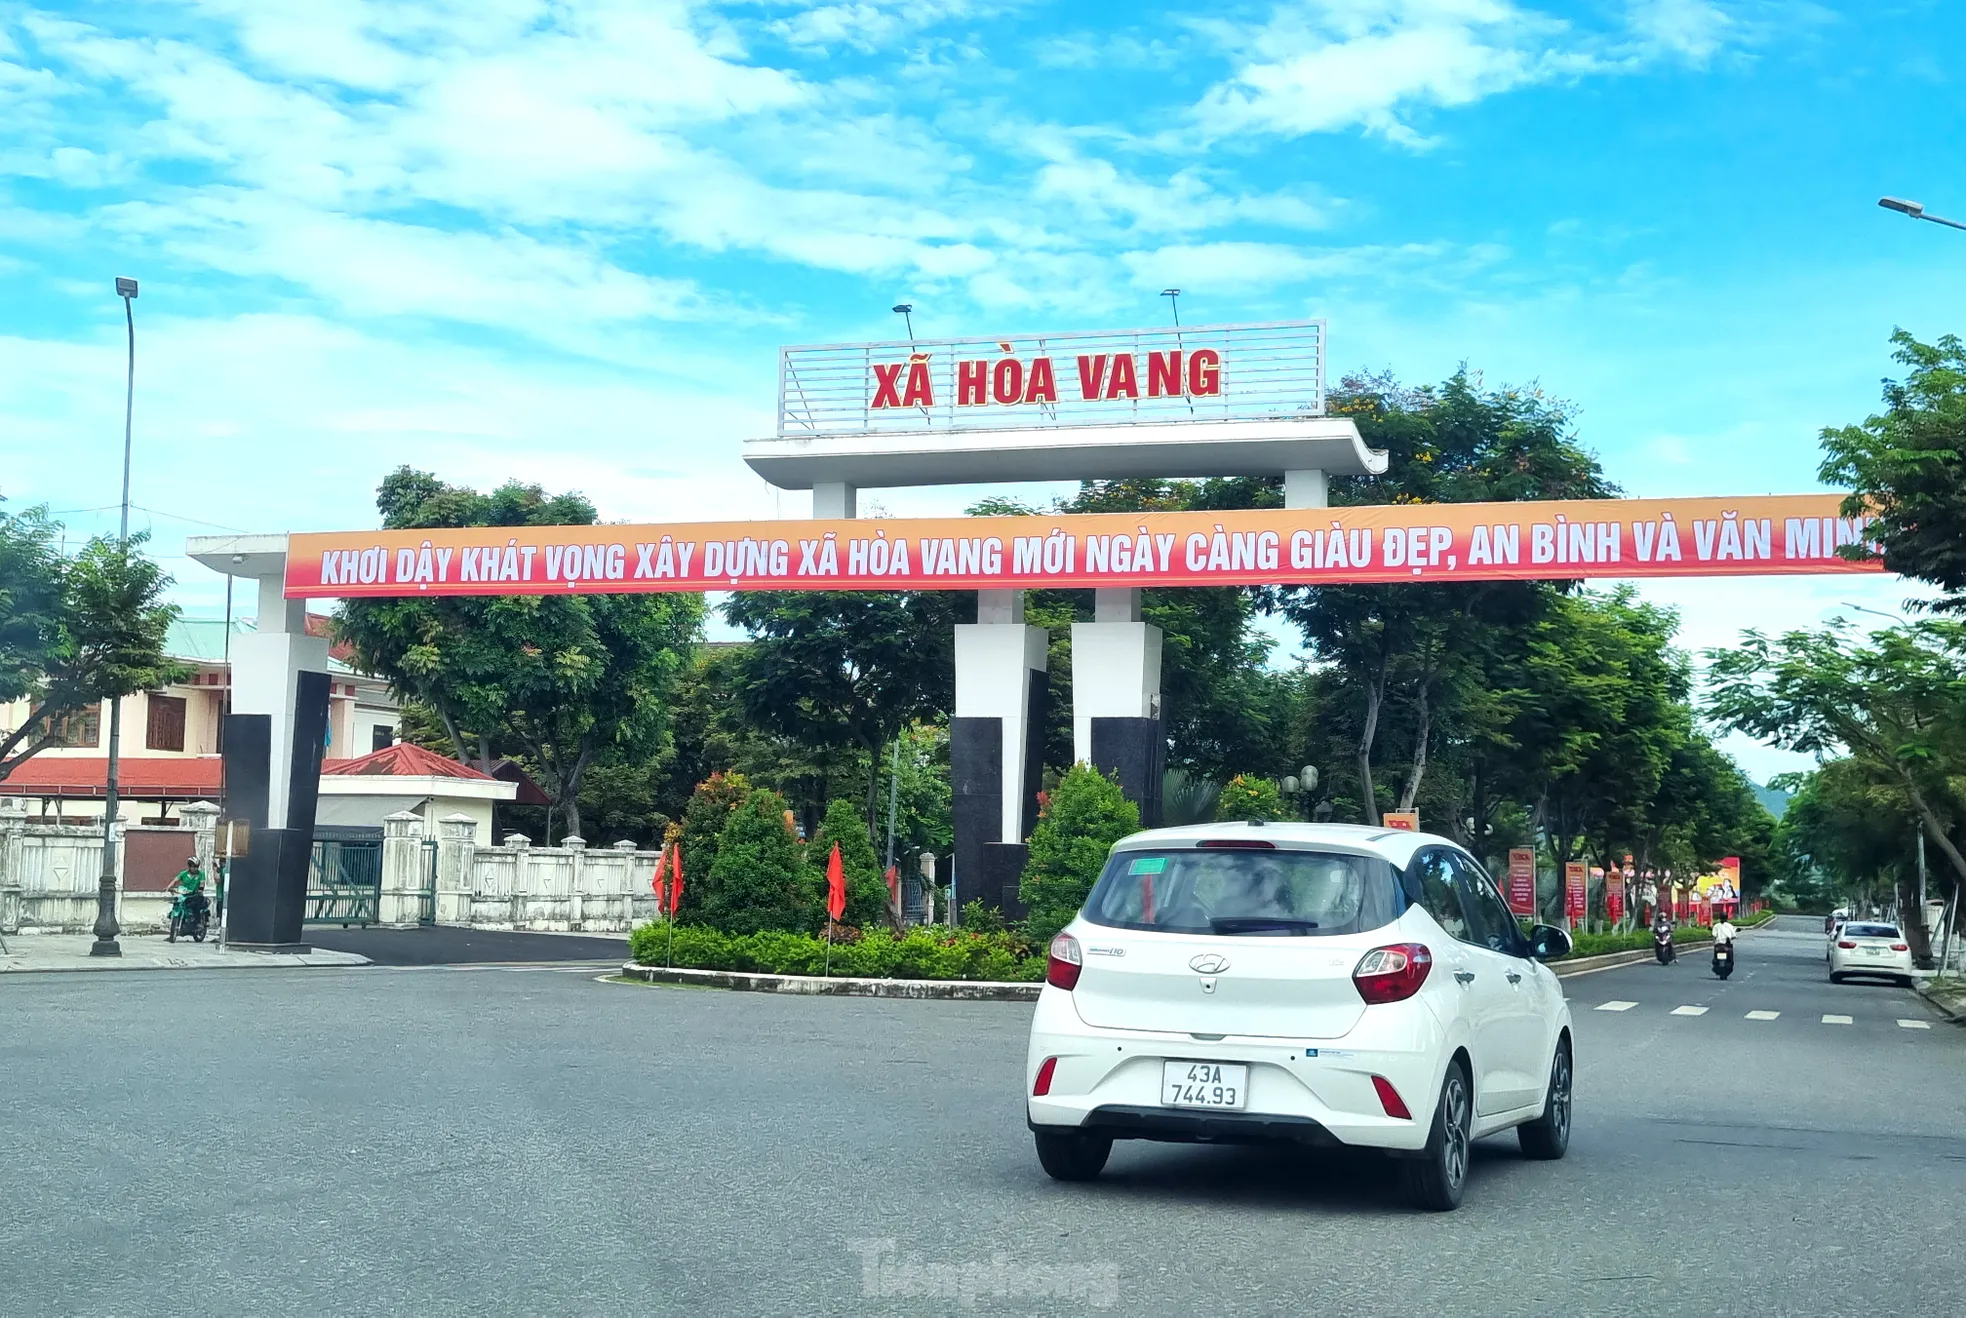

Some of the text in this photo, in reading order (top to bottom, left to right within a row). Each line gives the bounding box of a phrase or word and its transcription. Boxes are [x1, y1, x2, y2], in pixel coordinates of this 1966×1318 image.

[870, 342, 1221, 409] XÃ HÒA VANG
[320, 544, 388, 585] KHƠI
[395, 539, 453, 591] DẬY
[459, 538, 537, 582] KHÁT
[545, 542, 626, 589] VỌNG
[633, 534, 696, 579] XÂY
[703, 536, 789, 585] DỰNG
[797, 531, 839, 577] XÃ
[847, 529, 911, 576] HÒA
[919, 537, 1003, 576] VANG
[1012, 527, 1076, 574] MỚI
[1085, 525, 1176, 573] NGÀY
[1185, 523, 1279, 572] CÀNG
[1290, 520, 1372, 570] GIÀU
[1382, 524, 1457, 576] ĐẸP,
[1467, 524, 1520, 565] AN
[1531, 514, 1621, 564] BÌNH
[1632, 511, 1682, 563] VÀ
[1693, 510, 1771, 561] VĂN
[1171, 1084, 1236, 1106] 744.93
[1187, 1065, 1222, 1084] 43A
